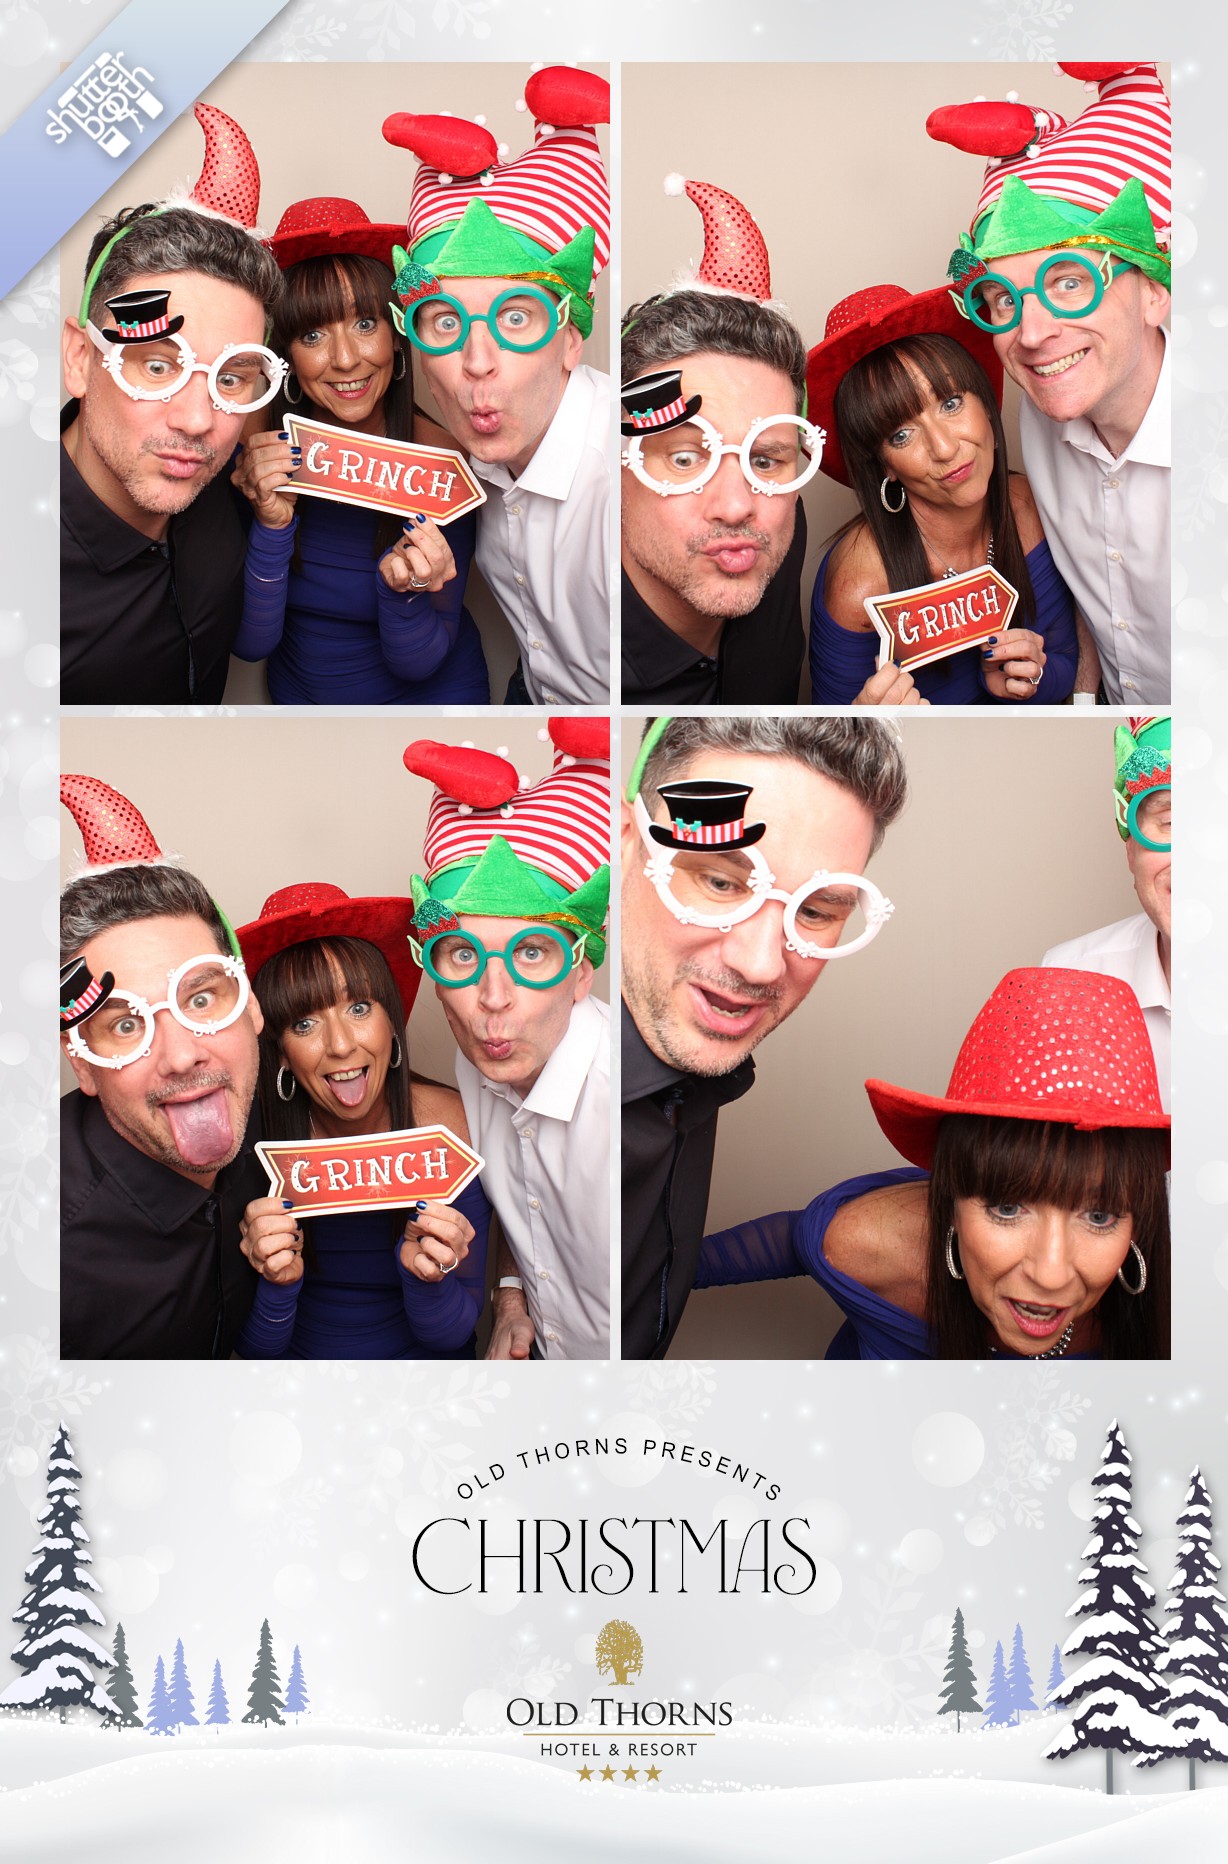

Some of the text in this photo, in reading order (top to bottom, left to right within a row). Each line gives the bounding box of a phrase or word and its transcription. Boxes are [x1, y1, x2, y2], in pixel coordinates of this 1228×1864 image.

[306, 441, 457, 502] GRINCH
[897, 584, 1001, 645] GRINCH
[290, 1147, 450, 1193] GRINCH
